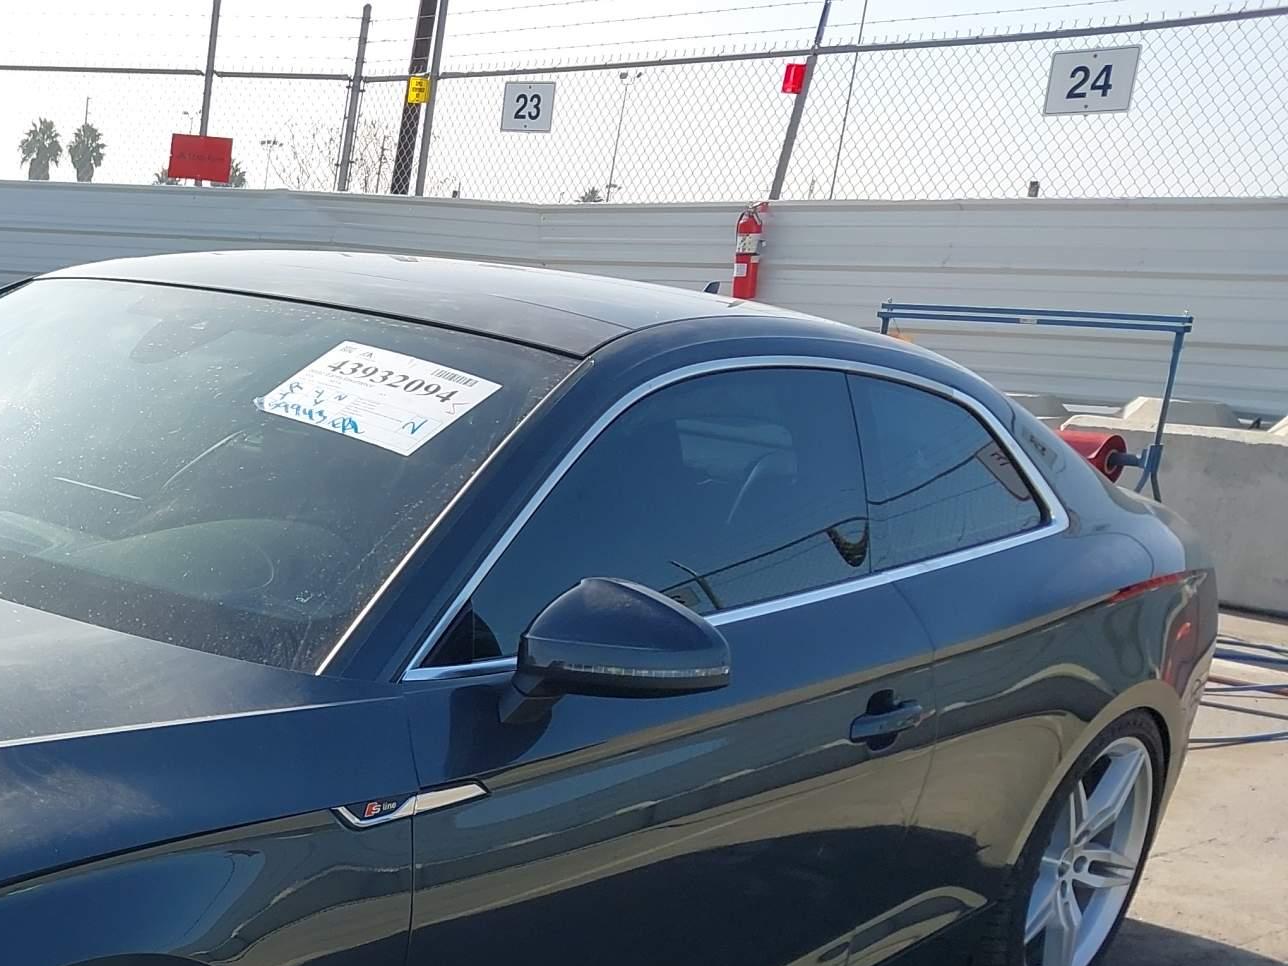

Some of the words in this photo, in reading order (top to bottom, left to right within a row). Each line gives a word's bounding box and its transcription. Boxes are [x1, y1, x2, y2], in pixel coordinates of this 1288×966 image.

[1065, 64, 1113, 99] 24
[513, 93, 542, 120] 23
[327, 359, 459, 403] 43932094
[382, 801, 397, 811] line
